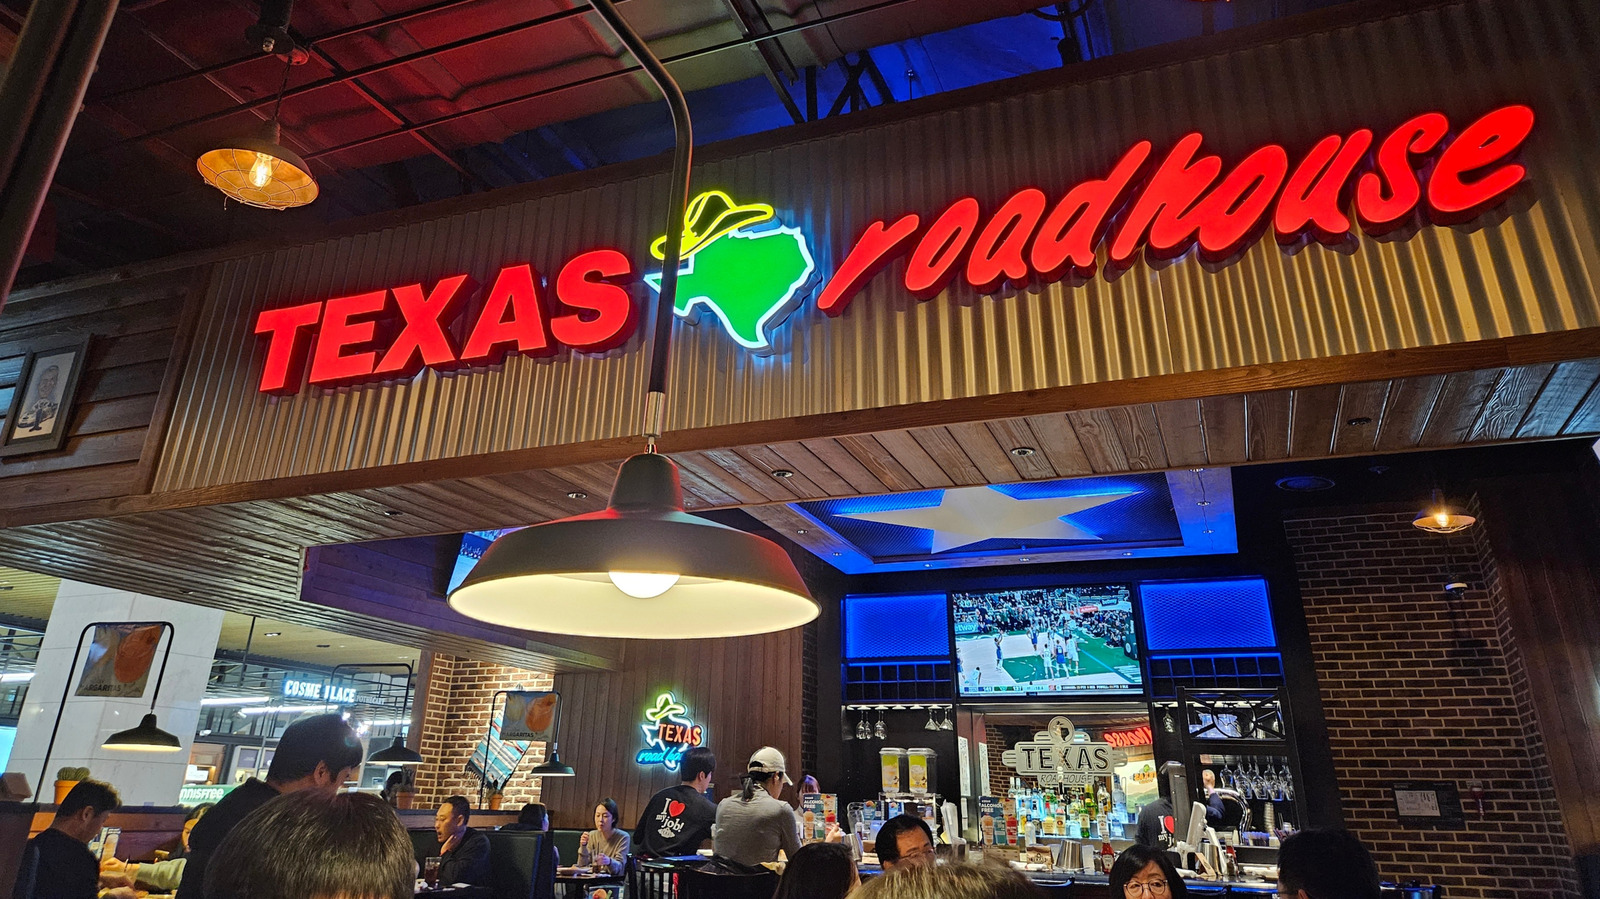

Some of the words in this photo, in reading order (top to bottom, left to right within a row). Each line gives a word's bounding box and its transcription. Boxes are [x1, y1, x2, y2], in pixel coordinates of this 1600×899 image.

[255, 249, 631, 392] TEXAS
[818, 105, 1534, 310] roadhouse
[284, 680, 321, 698] COSME
[658, 723, 702, 747] TEXAS
[1020, 746, 1110, 770] TEXAS
[1041, 773, 1093, 785] ROAHOUSE
[661, 797, 672, 815] I
[656, 814, 667, 822] my
[661, 816, 685, 832] job!
[1158, 815, 1167, 834] I
